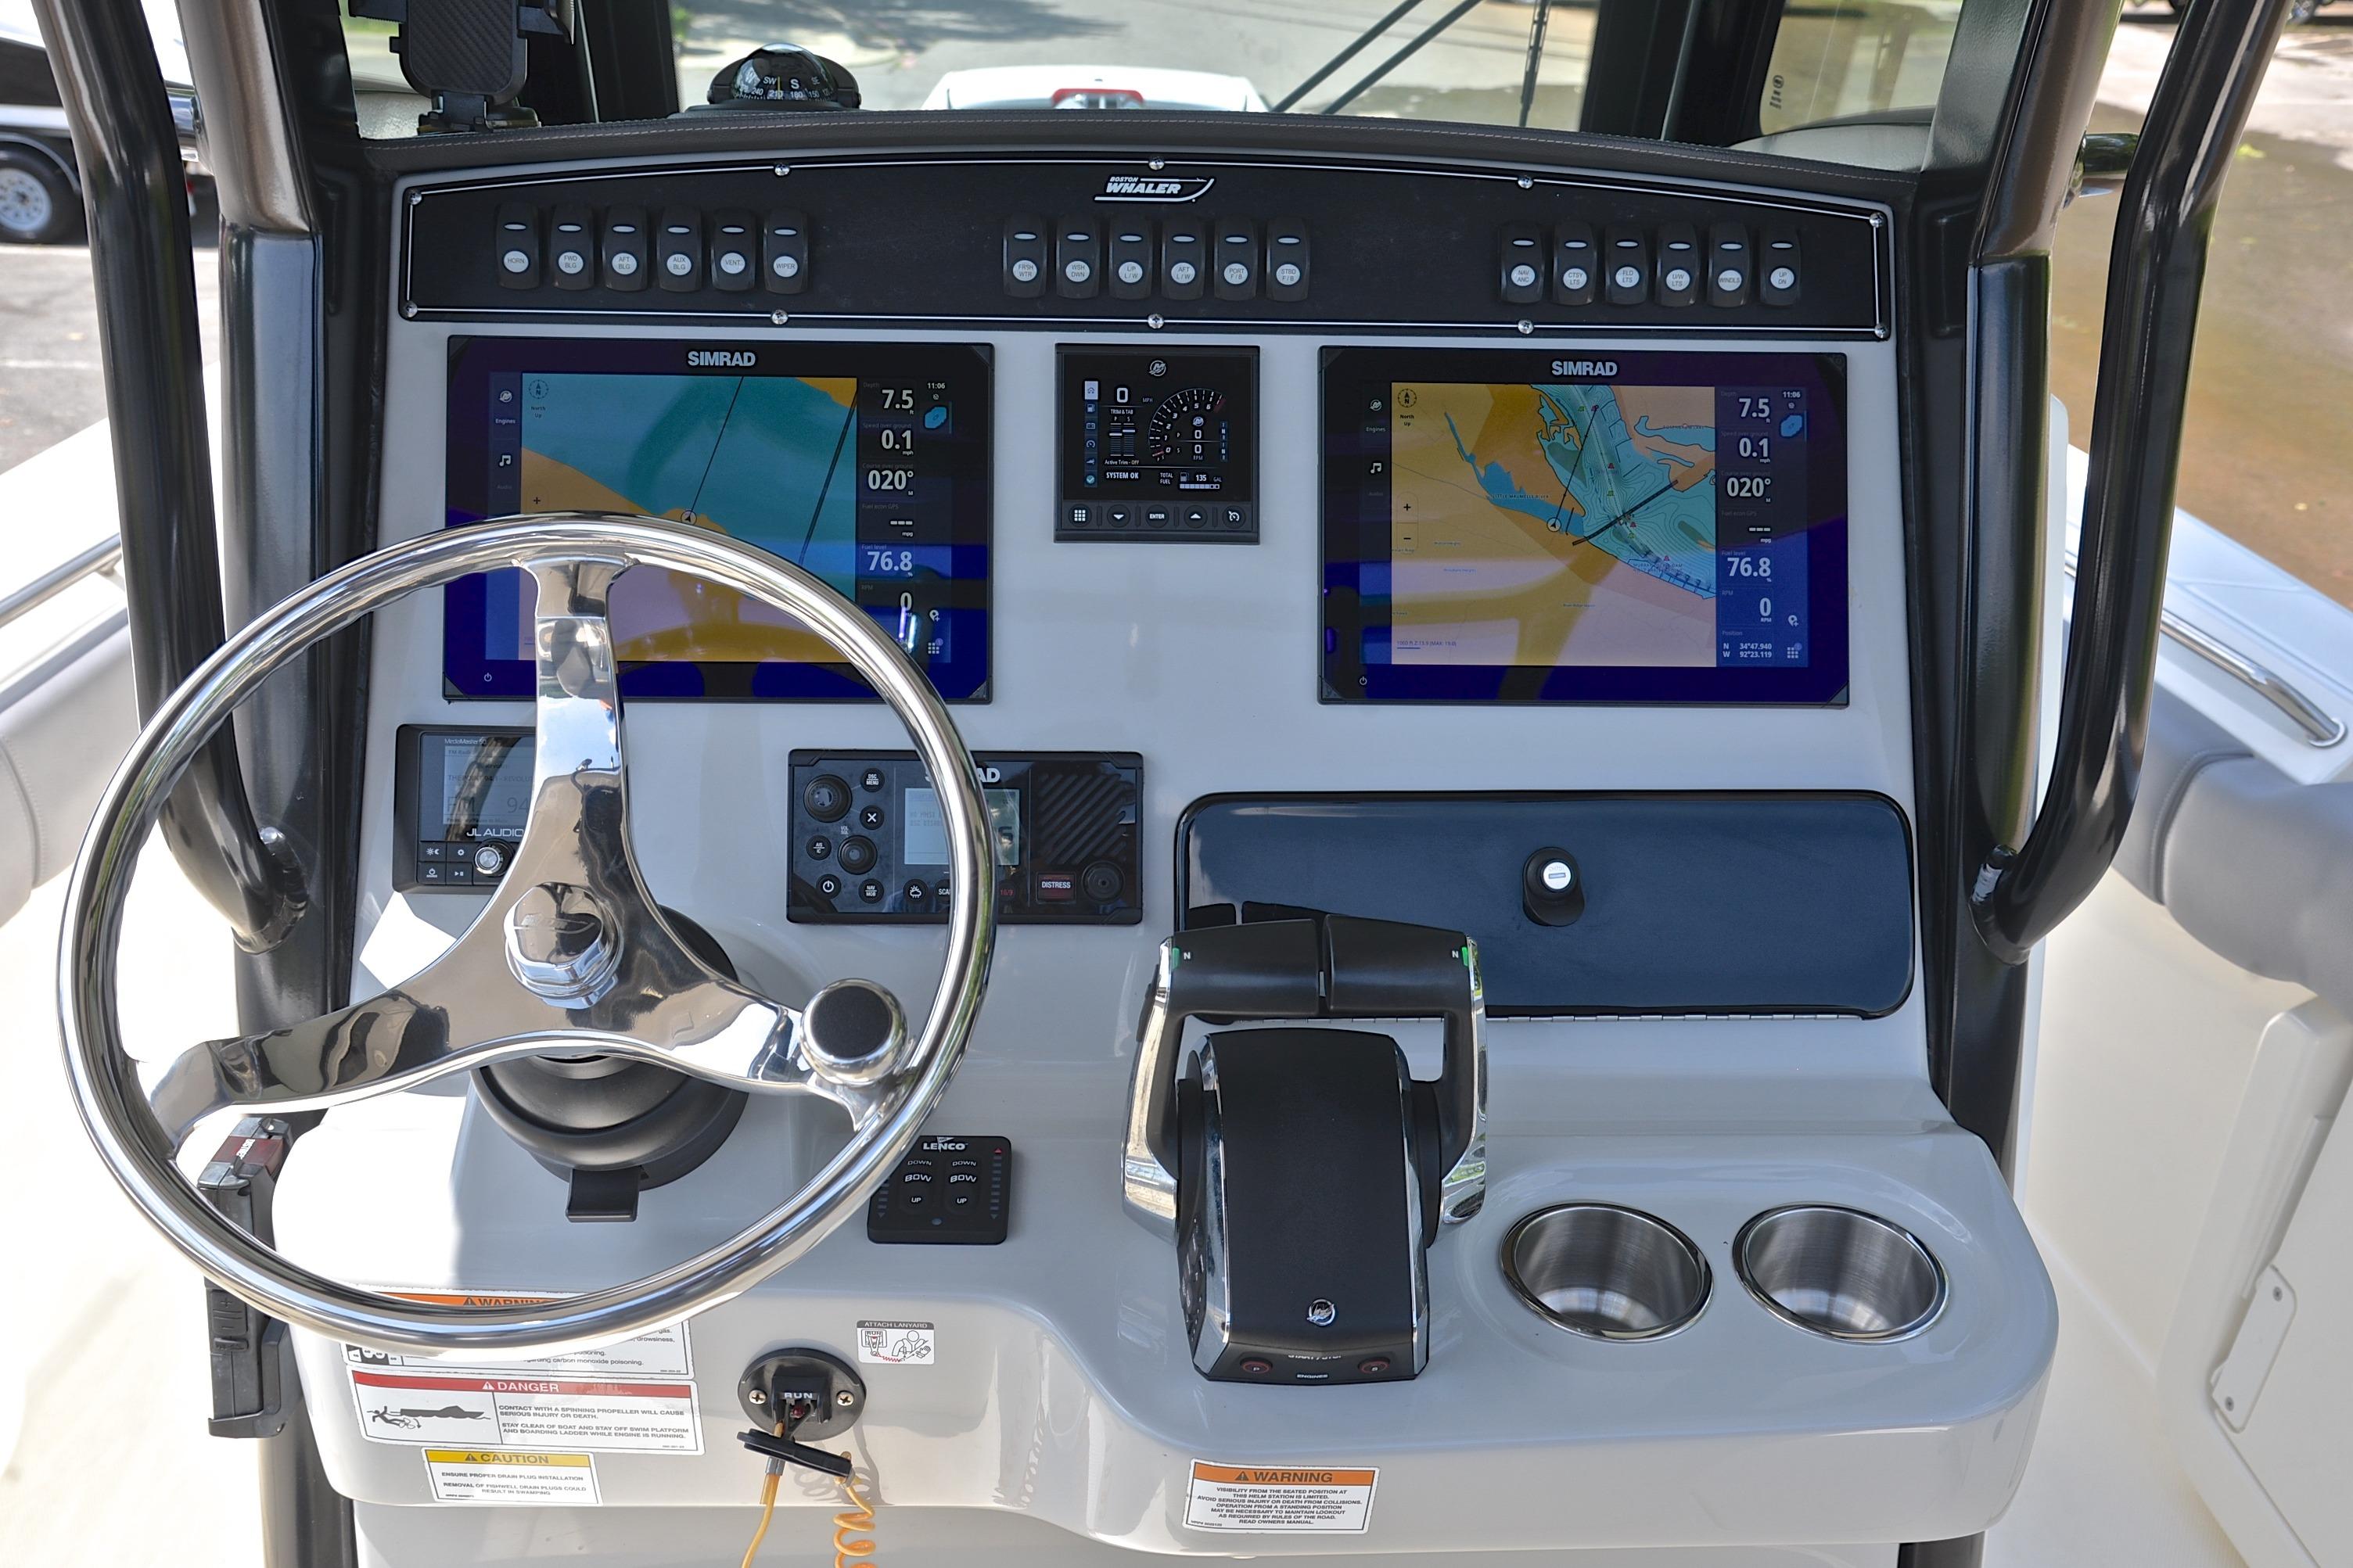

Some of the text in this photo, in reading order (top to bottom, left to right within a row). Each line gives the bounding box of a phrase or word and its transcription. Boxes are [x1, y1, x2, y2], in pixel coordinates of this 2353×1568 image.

[790, 78, 799, 89] S
[1106, 183, 1181, 194] WHALER
[688, 351, 756, 367] SIMRAD
[1551, 361, 1618, 376] SIMRAD
[882, 389, 914, 409] 7.5
[1116, 387, 1129, 404] 0
[1738, 398, 1770, 418] 7.5
[882, 429, 911, 450] 0.1
[1194, 430, 1202, 439] 0
[1194, 444, 1202, 454] 0
[1739, 437, 1769, 457] 0.1
[868, 469, 914, 490] 020°
[1726, 477, 1772, 497] 020°
[868, 551, 913, 571] 76.8
[1727, 557, 1771, 577] 76.8
[900, 592, 913, 612] 0
[1759, 597, 1771, 617] 0
[467, 828, 525, 837] JL AUDIO
[923, 1143, 966, 1151] LENCO
[905, 1174, 932, 1182] BOW
[497, 1381, 559, 1393] DANGER
[480, 1454, 549, 1464] CAUTION
[1254, 1471, 1332, 1483] WARNING
